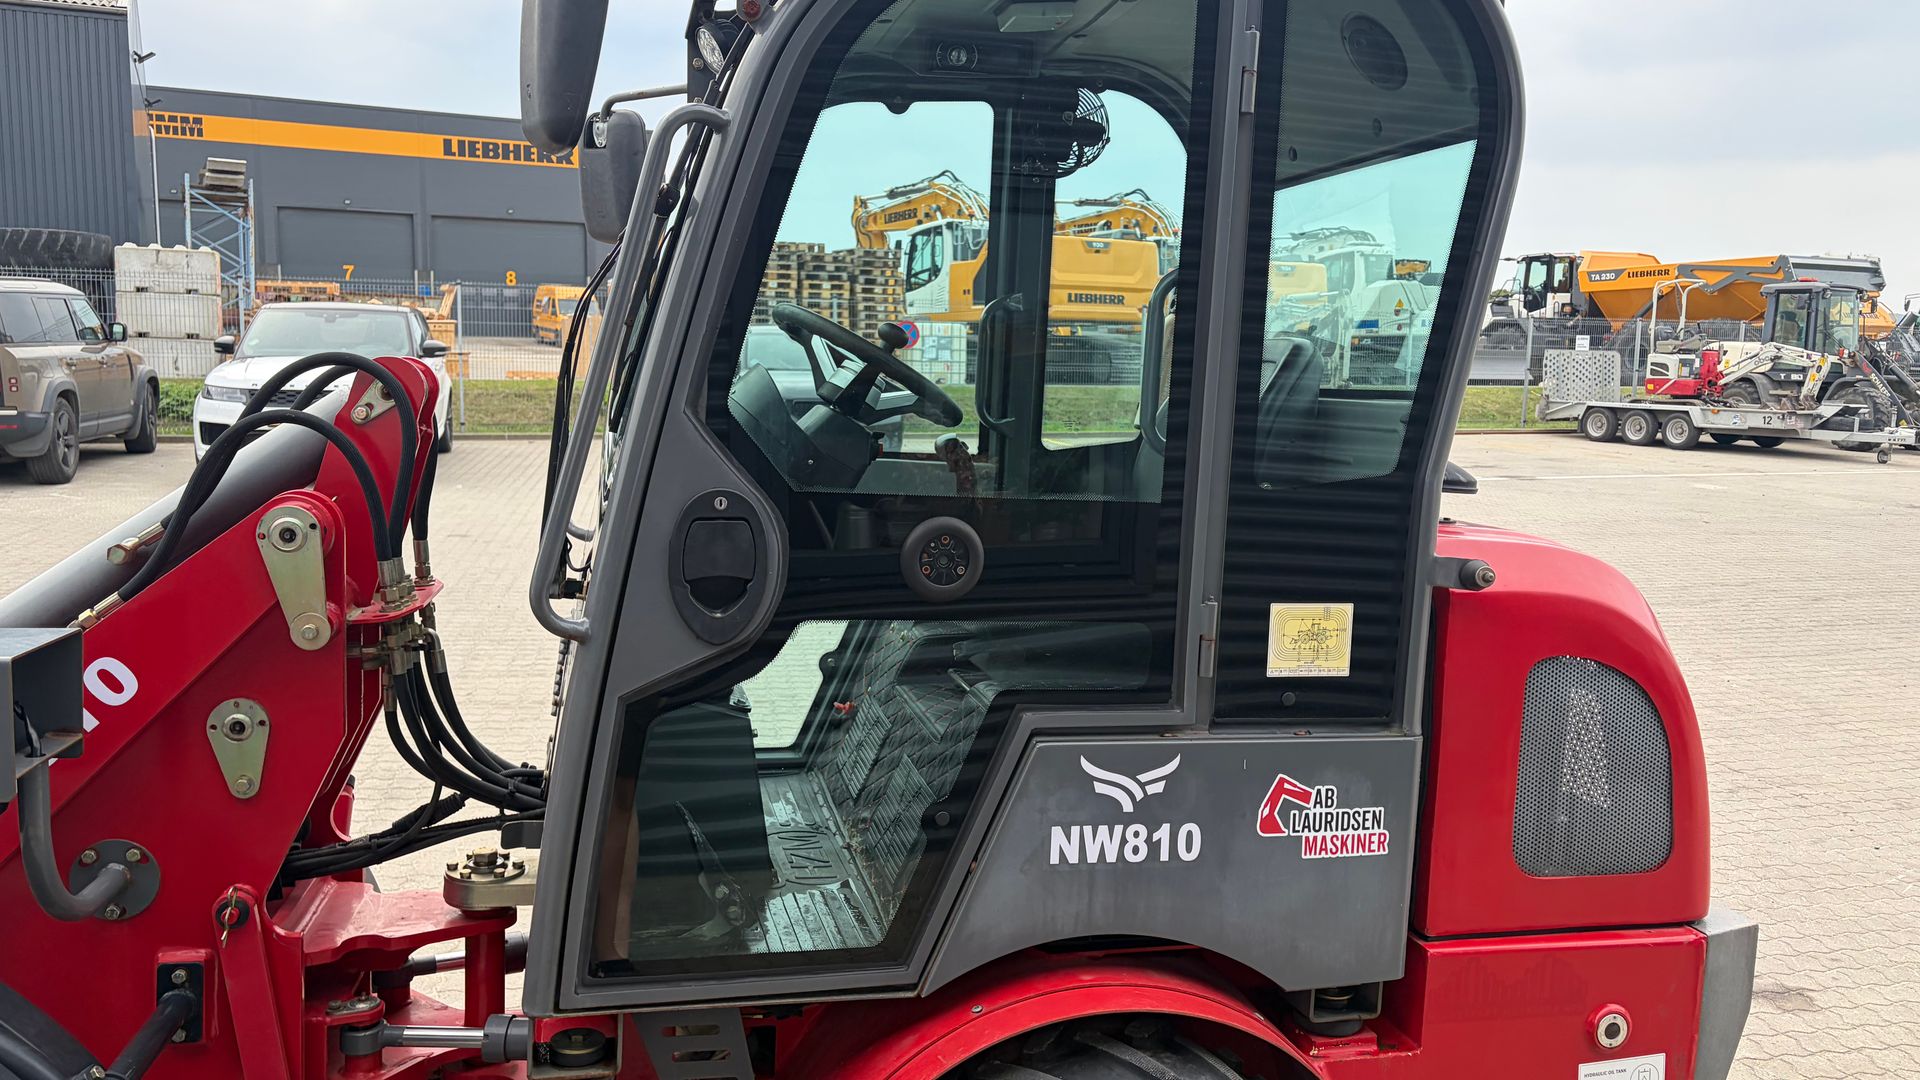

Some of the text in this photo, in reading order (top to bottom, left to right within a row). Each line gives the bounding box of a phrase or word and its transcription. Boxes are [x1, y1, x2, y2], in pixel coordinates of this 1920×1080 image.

[342, 264, 355, 281] 7
[505, 270, 517, 286] 8
[1591, 272, 1616, 281] TA 230
[1627, 268, 1670, 279] LIEBHERR
[1067, 292, 1126, 305] LIEBHERR
[1762, 415, 1773, 425] 12
[1313, 788, 1335, 809] AB
[1292, 809, 1382, 834] LAURIDSEN
[1049, 822, 1202, 865] NW810
[1303, 832, 1387, 857] MASKINER
